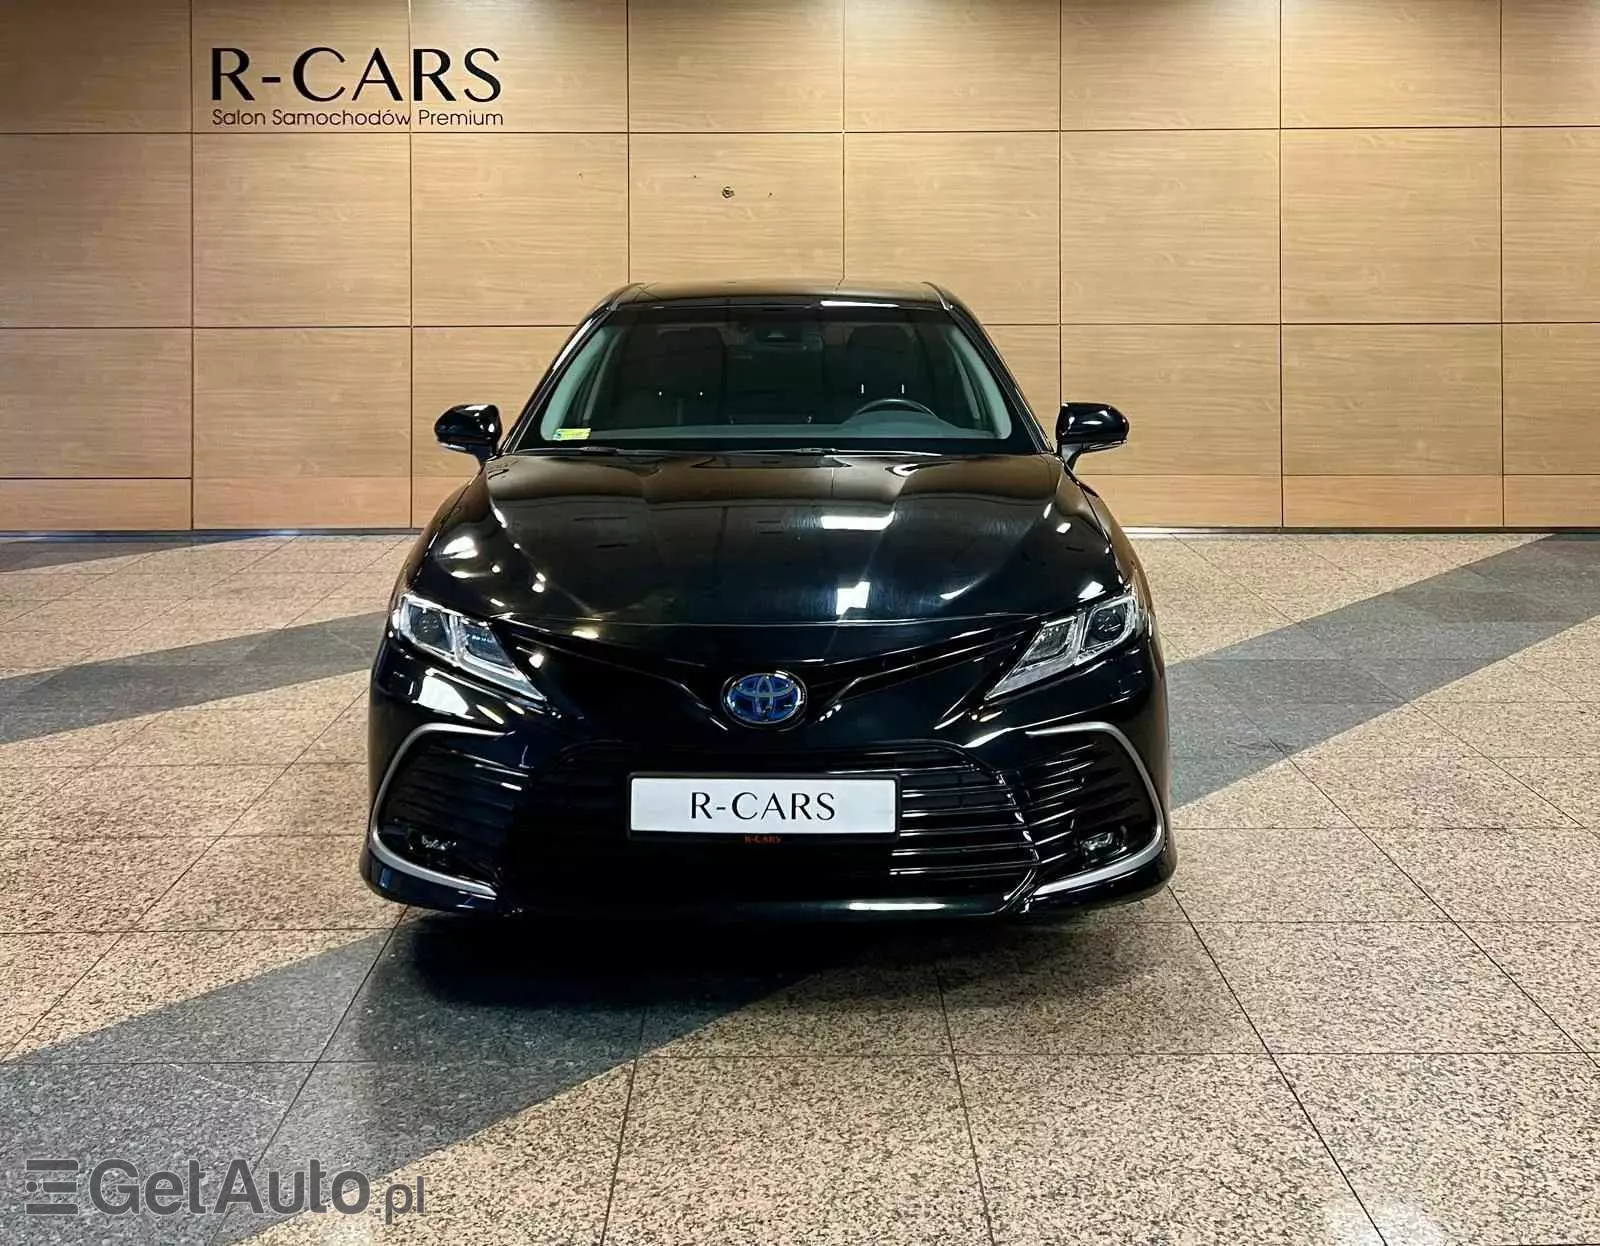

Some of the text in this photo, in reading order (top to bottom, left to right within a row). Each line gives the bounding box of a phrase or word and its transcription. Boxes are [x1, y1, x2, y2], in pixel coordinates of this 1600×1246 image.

[211, 47, 501, 103] R-CARS
[212, 109, 503, 125] Salon Samochodów Premium
[690, 792, 836, 820] R-CARS
